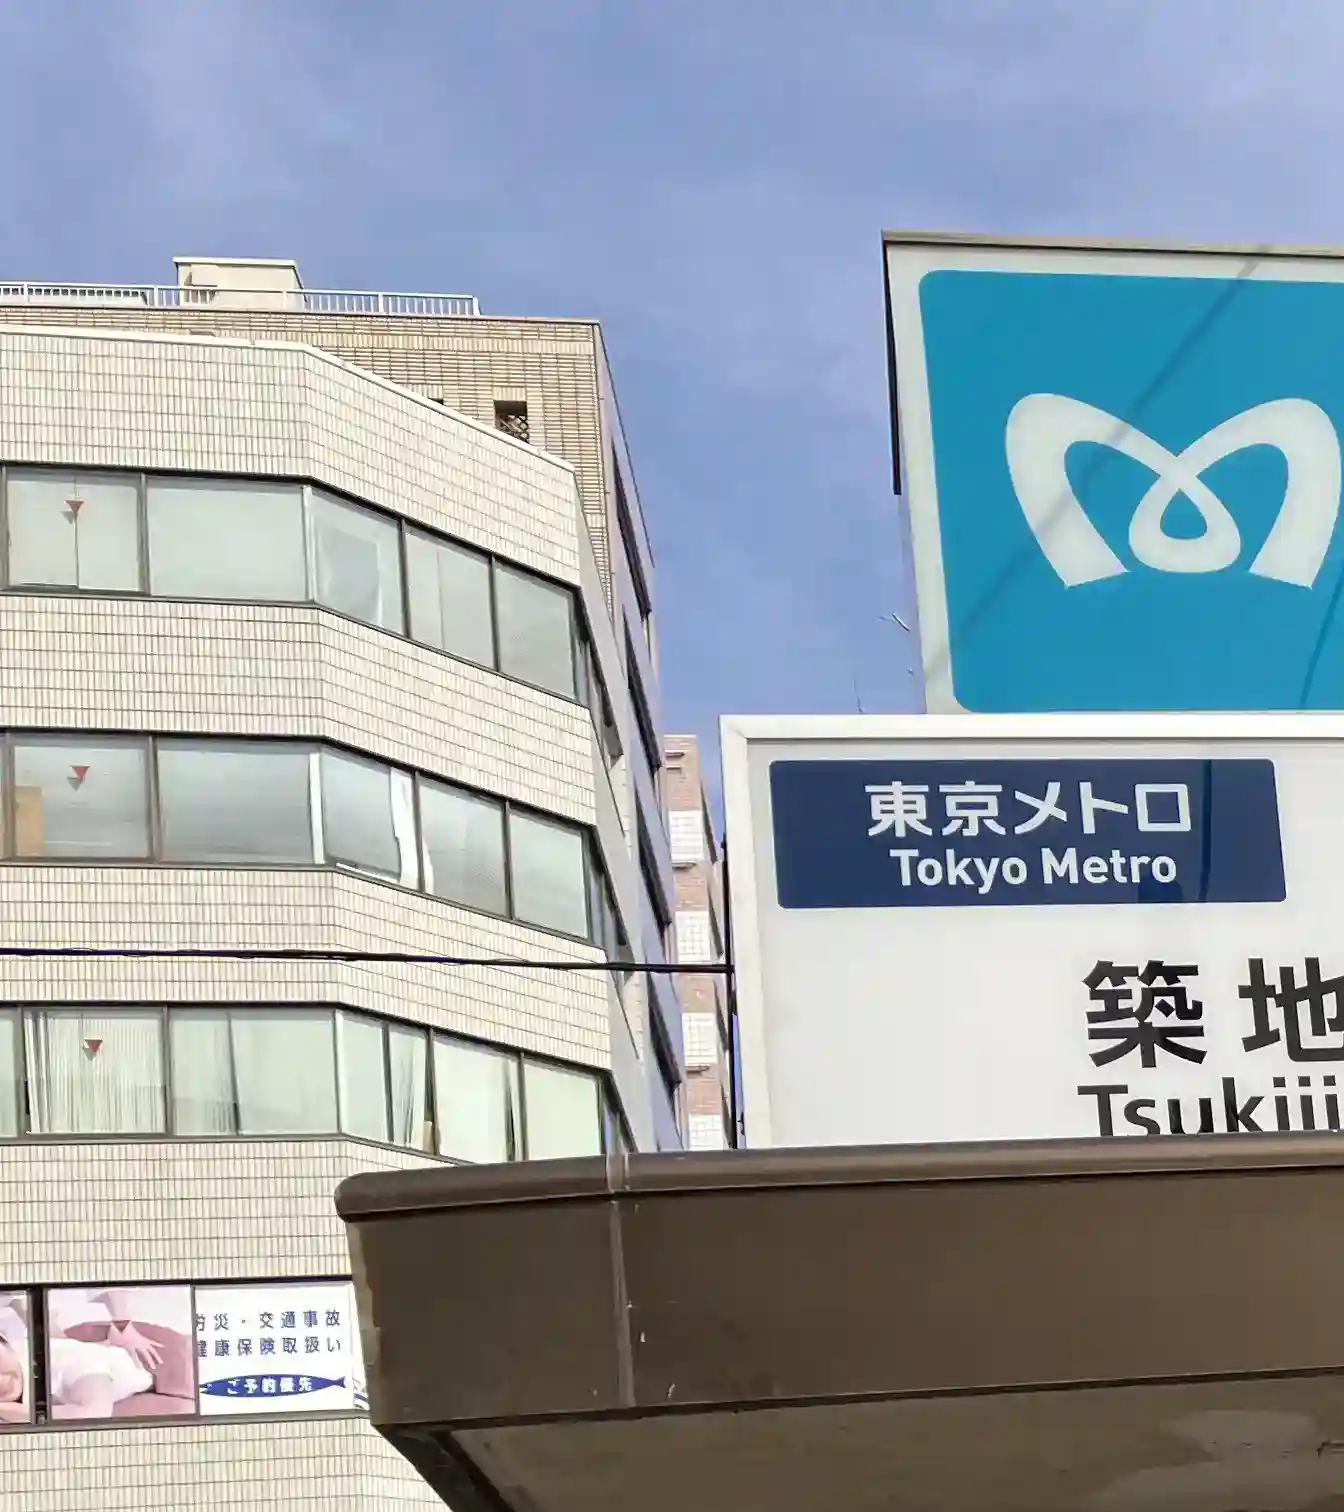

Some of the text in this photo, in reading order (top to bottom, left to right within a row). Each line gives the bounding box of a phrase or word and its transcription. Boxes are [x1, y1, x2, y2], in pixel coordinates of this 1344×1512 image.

[865, 780, 1191, 838] 東京メトロ
[889, 844, 1177, 893] Tokyo Metro
